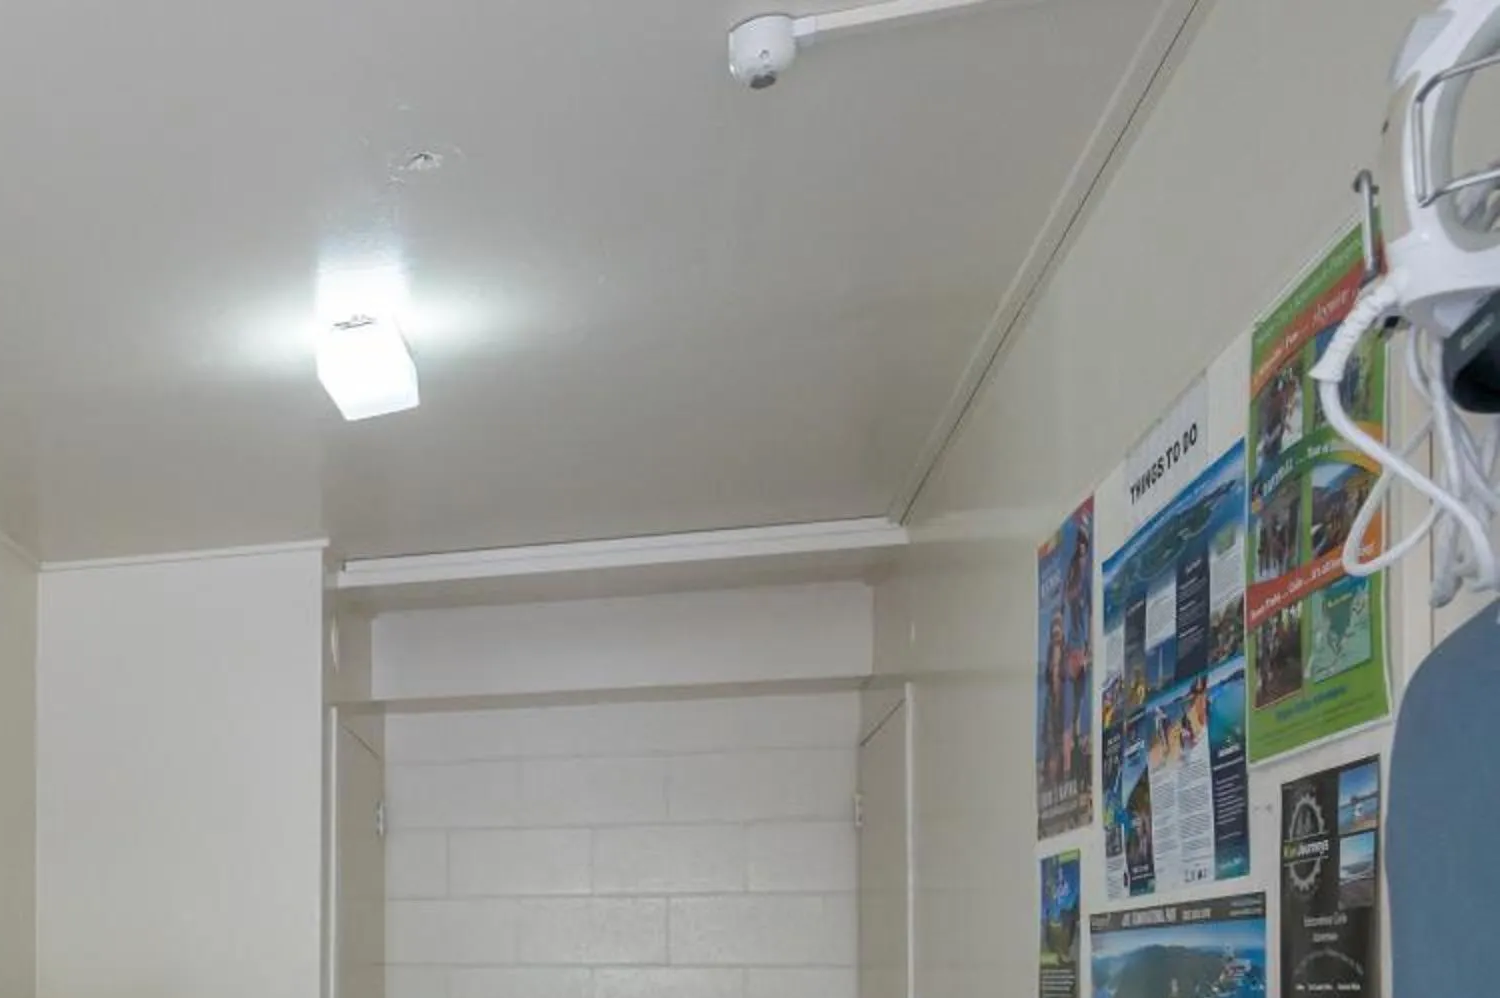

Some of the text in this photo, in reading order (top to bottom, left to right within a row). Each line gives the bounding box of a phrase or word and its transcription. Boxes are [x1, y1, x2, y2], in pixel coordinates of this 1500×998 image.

[1130, 422, 1198, 505] THINGS TO DO
